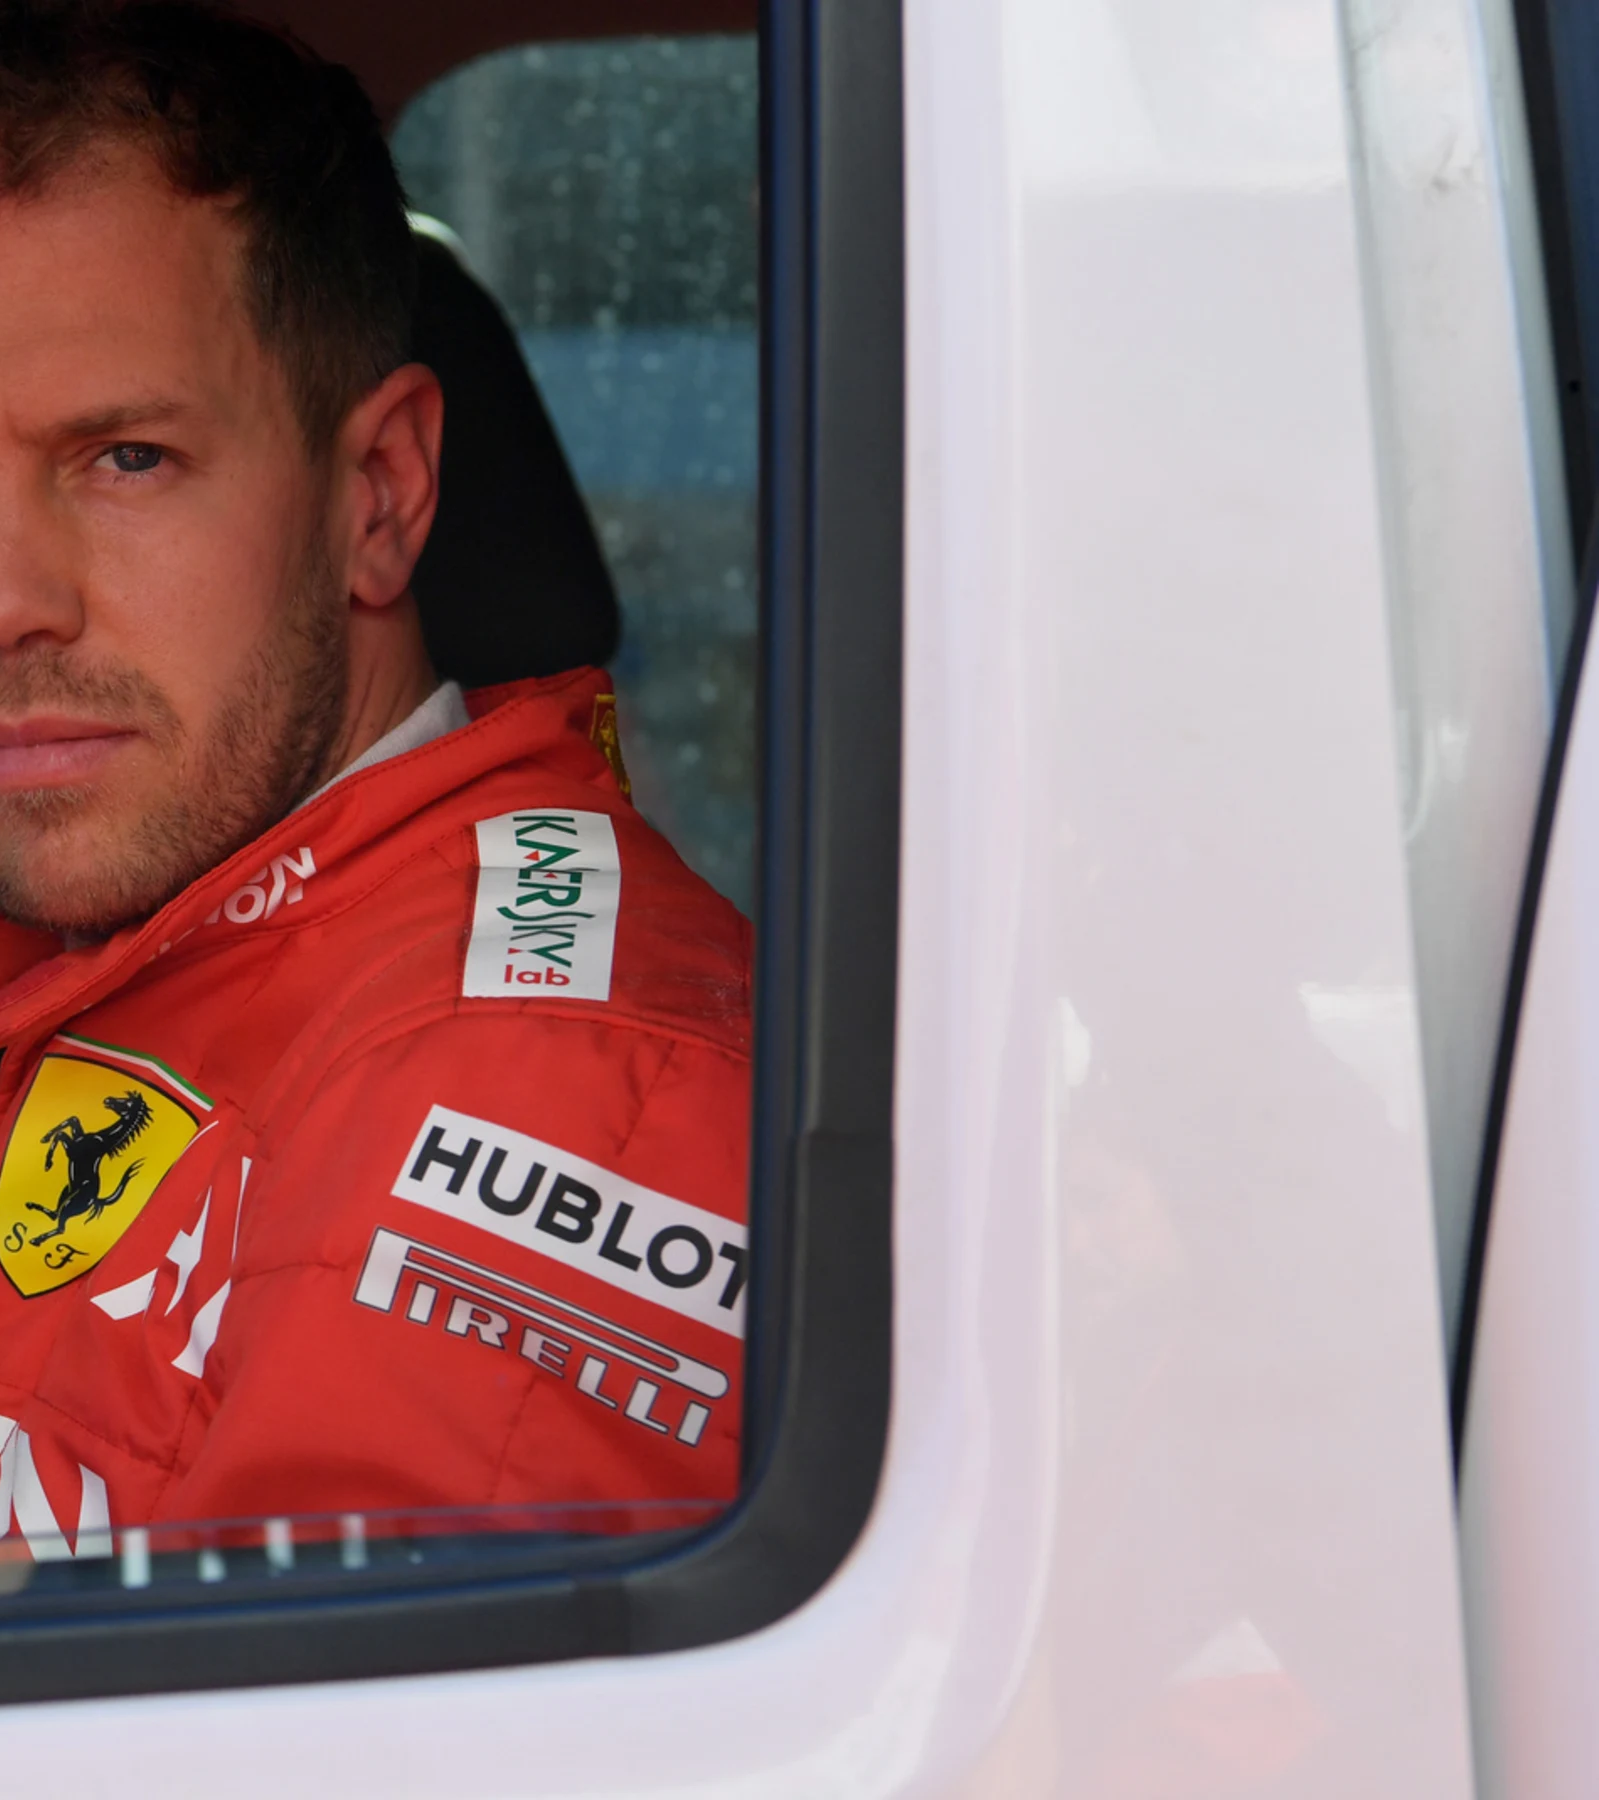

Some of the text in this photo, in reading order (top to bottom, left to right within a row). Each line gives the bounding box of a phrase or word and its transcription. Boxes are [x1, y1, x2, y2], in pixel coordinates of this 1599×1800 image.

[503, 964, 571, 987] lab
[409, 1125, 748, 1311] HUBLOT
[353, 1225, 730, 1449] PIRELLI
